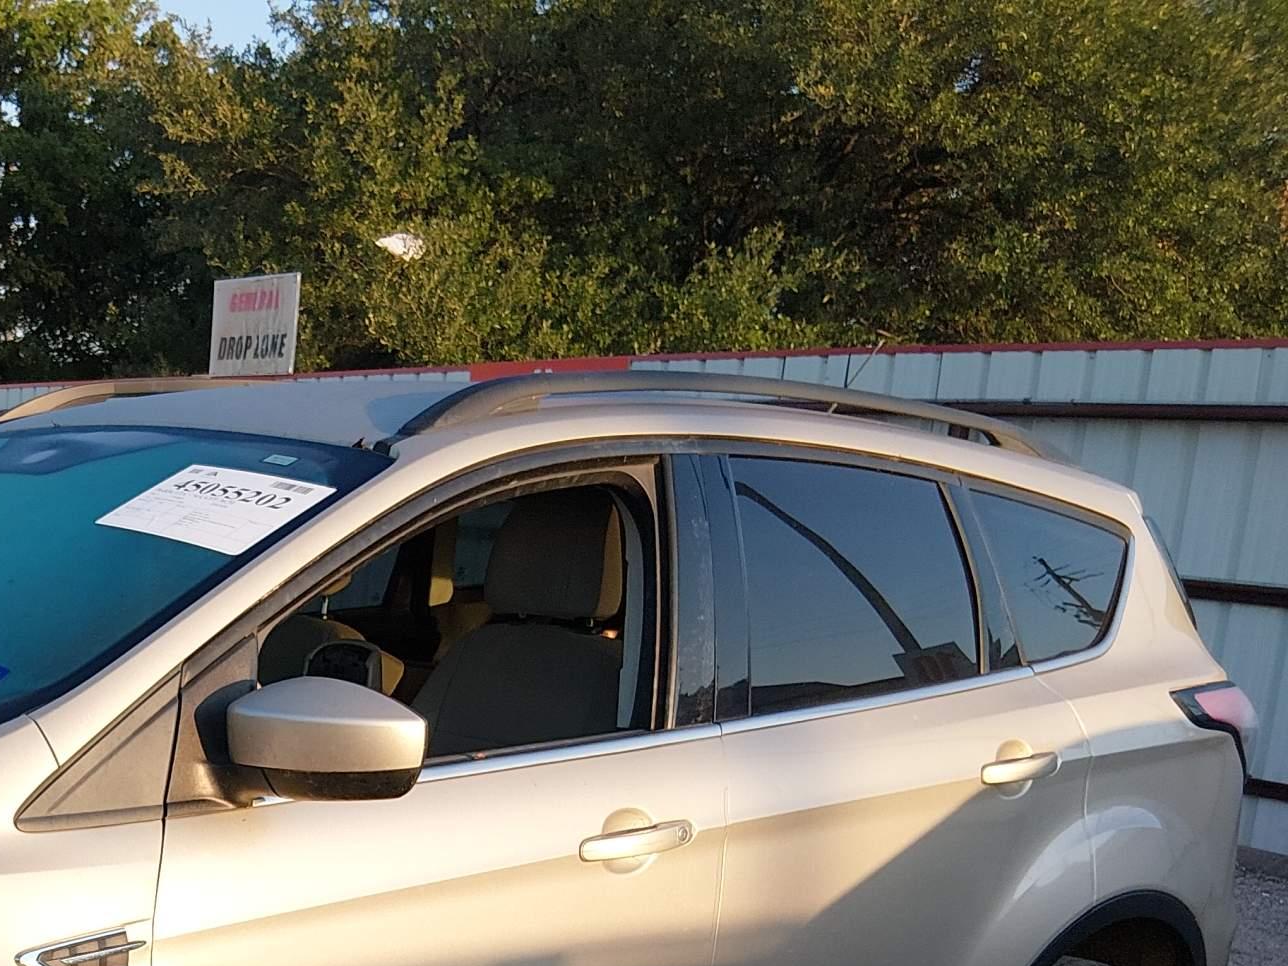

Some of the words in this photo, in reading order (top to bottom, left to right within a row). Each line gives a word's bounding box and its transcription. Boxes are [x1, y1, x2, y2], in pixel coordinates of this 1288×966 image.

[217, 335, 252, 360] DROP
[253, 333, 287, 359] ZONE
[173, 479, 292, 510] 45055202
